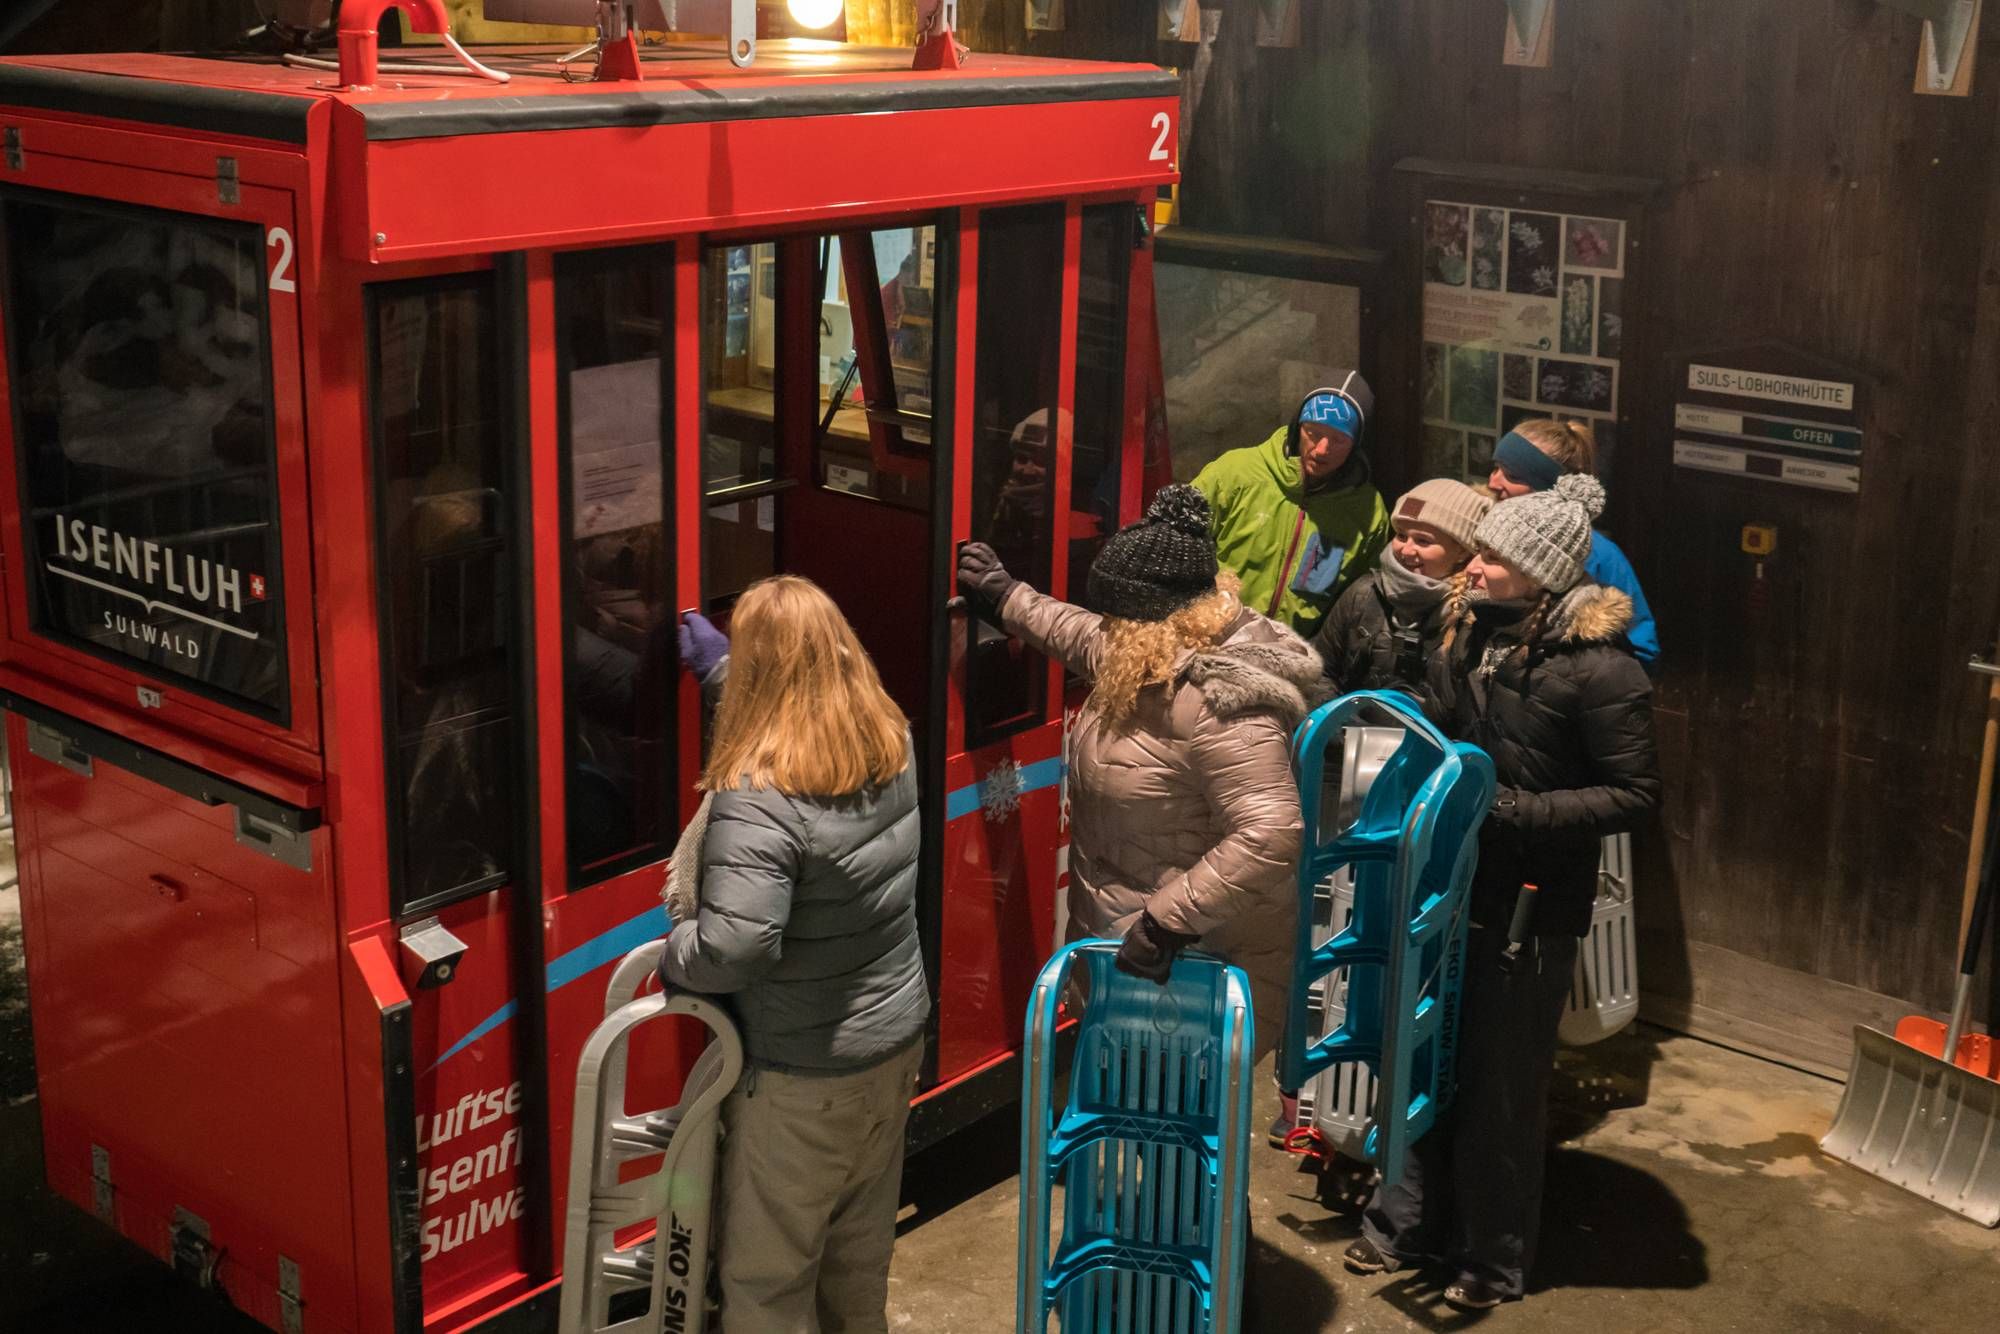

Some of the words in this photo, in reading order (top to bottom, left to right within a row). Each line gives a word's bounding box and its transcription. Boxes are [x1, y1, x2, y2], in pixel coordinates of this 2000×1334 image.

[1149, 111, 1170, 161] 2
[267, 227, 296, 293] 2
[1696, 370, 1844, 404] SULS-LOBHORNHÜTTE
[1793, 428, 1834, 445] OFFEN
[56, 514, 241, 613] ISENFLUH
[104, 611, 200, 659] SULWALD
[416, 1081, 522, 1153] Luftse
